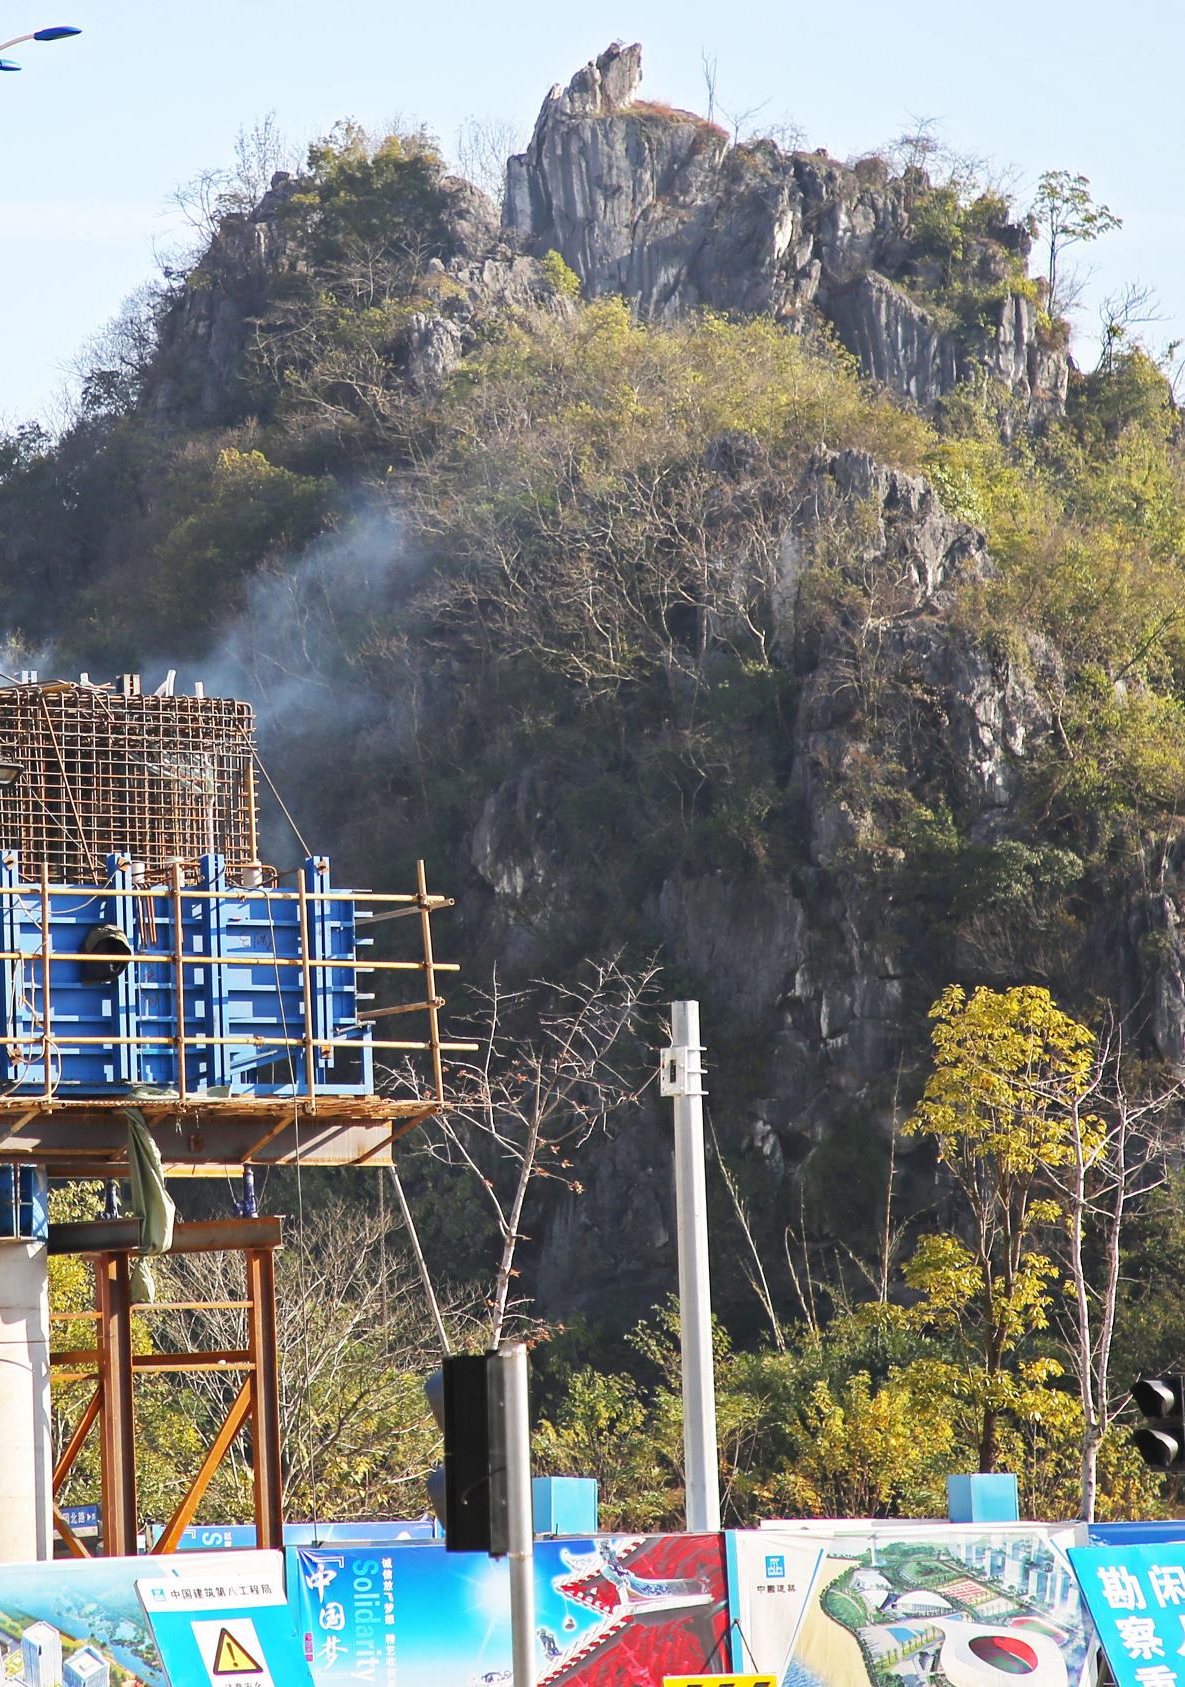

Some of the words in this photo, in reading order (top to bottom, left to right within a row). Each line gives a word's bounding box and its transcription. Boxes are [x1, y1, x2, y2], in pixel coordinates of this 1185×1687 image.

[170, 1584, 272, 1600] 中国建筑第八工程局
[351, 1559, 382, 1681] Solidarity
